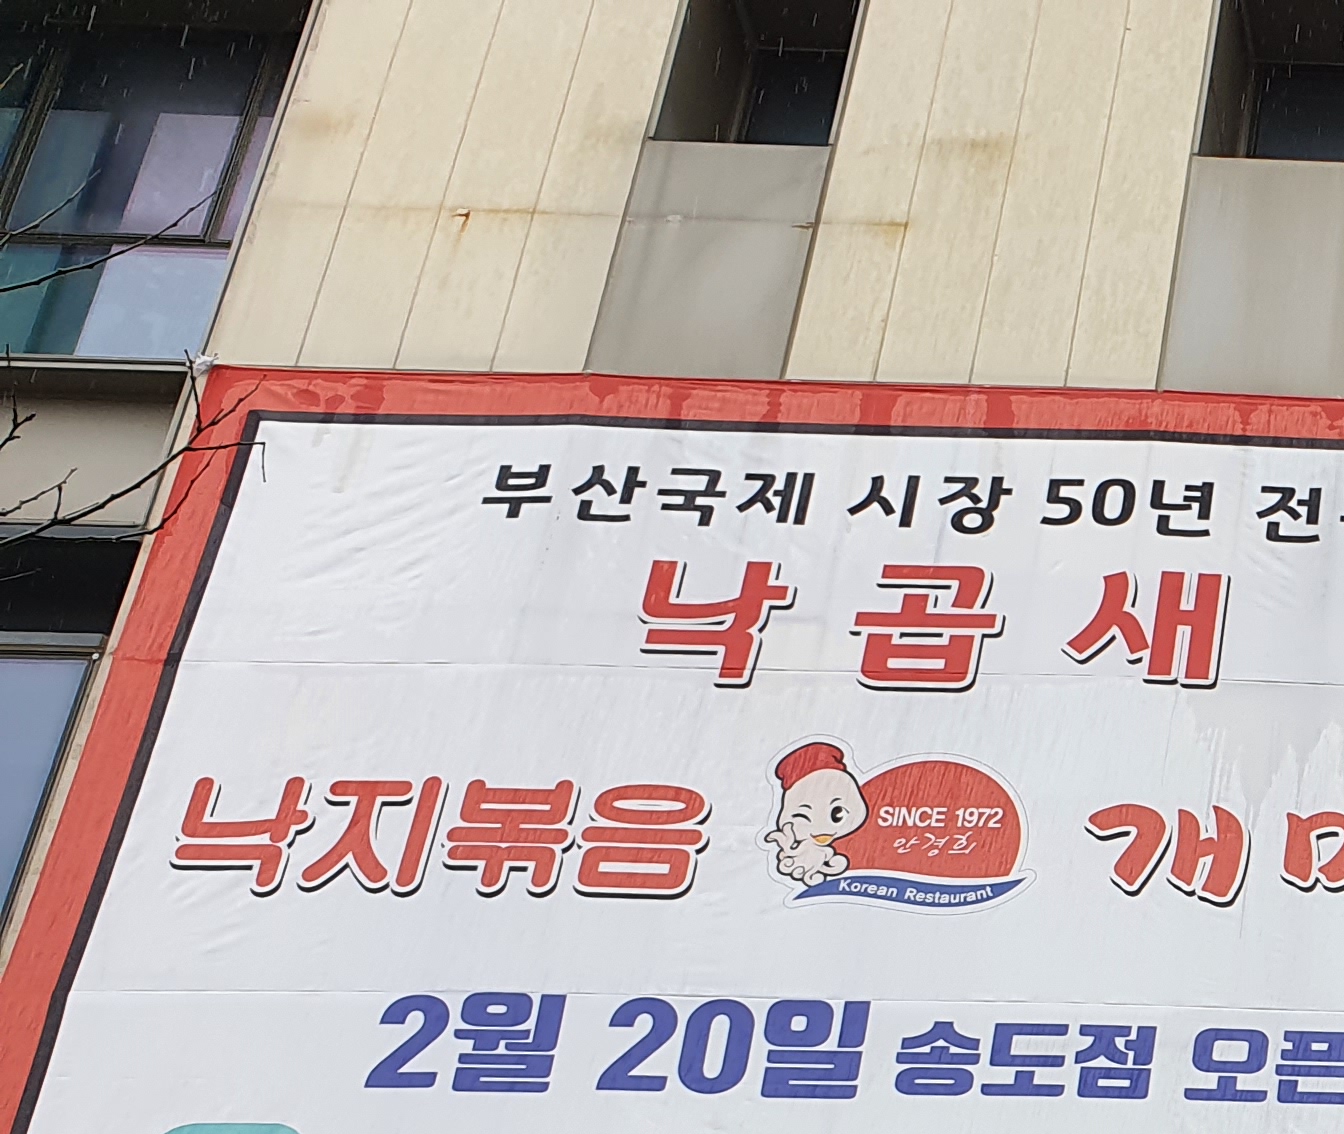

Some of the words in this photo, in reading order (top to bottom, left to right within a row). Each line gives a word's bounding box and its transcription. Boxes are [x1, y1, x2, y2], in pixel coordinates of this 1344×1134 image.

[480, 463, 816, 528] 부산국제
[846, 474, 1014, 536] 시장
[1038, 477, 1216, 539] 50년
[172, 776, 708, 896] 낙지볶음
[877, 806, 947, 828] SINCE
[954, 807, 1004, 829] 1972
[838, 879, 898, 899] Korean
[904, 885, 994, 905] Restaurant
[363, 991, 567, 1094] 2월
[595, 997, 871, 1100] 20일
[893, 1020, 1156, 1101] 송도점
